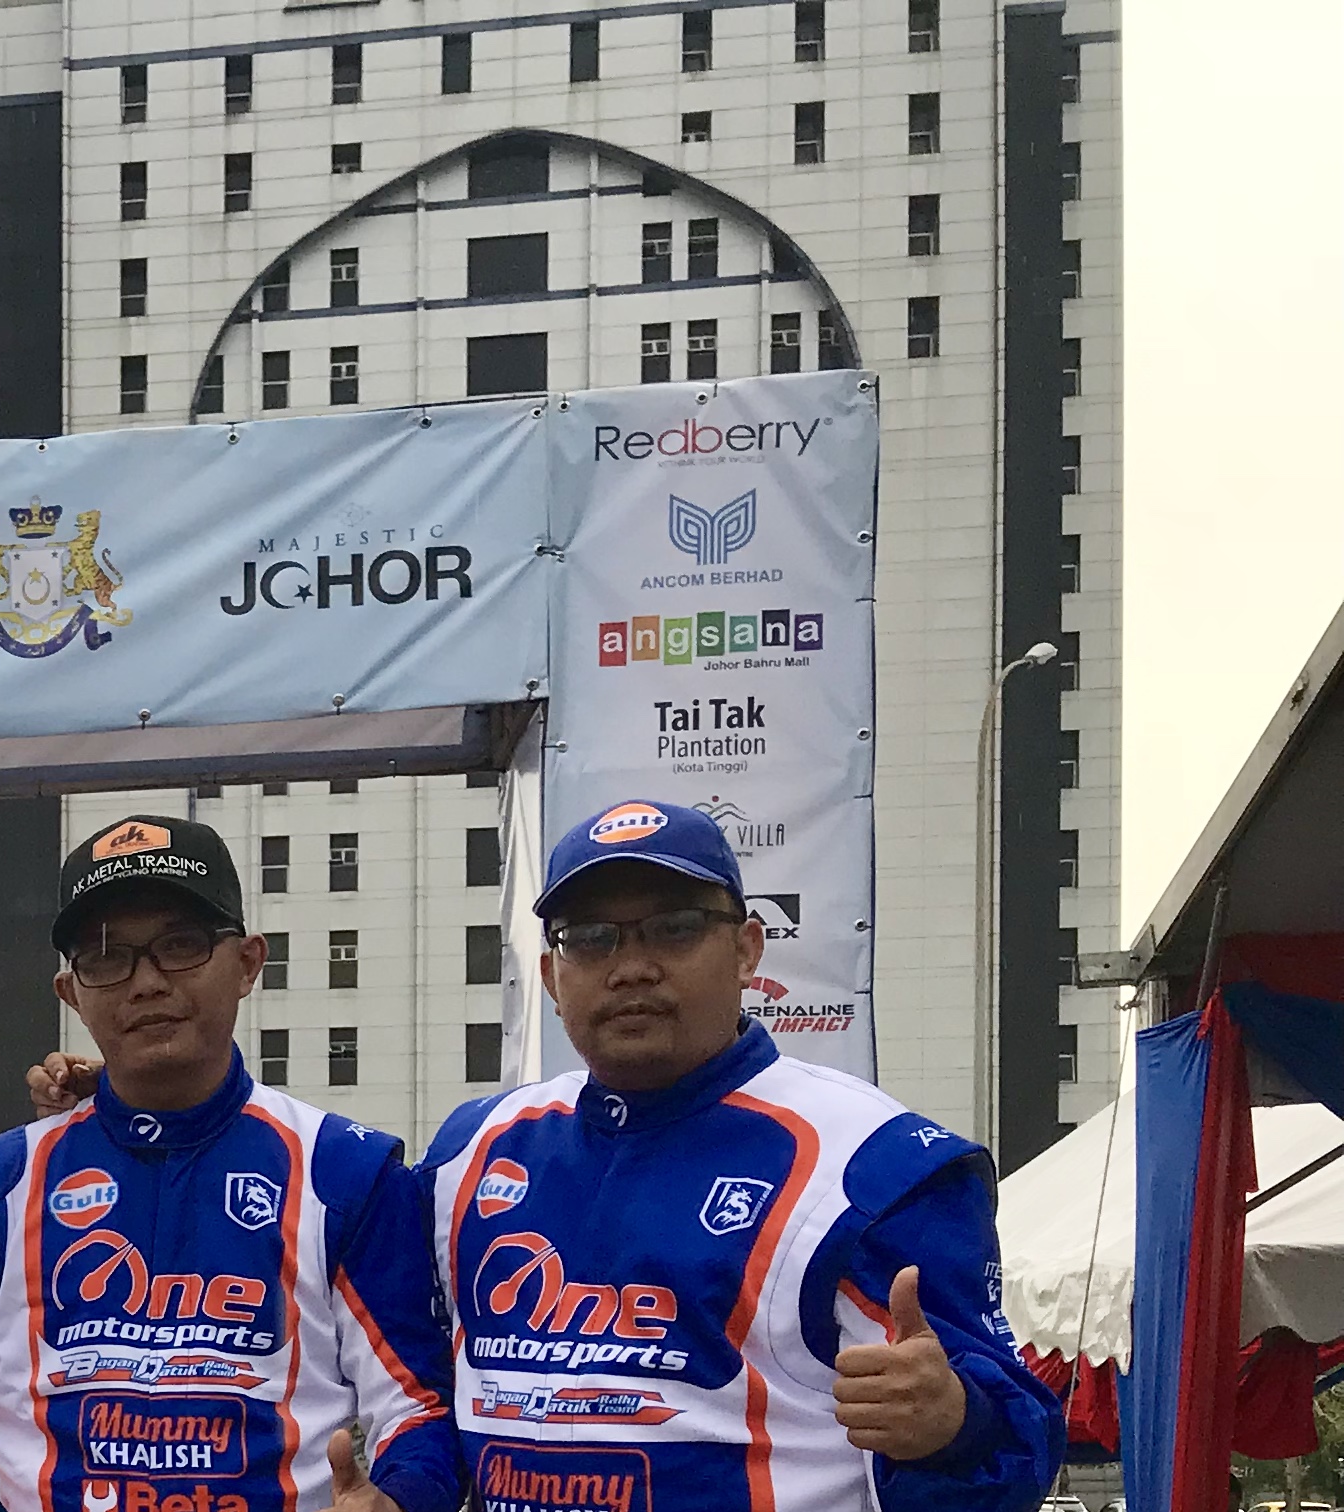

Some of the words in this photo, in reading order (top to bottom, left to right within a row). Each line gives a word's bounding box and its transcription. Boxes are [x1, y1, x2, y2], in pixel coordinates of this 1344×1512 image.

[595, 418, 820, 461] Redberry
[258, 524, 444, 554] MAJESTIC
[641, 573, 704, 589] ANCOM
[711, 569, 783, 585] BERHAD
[600, 612, 822, 665] angsana
[704, 658, 741, 671] Johor
[744, 657, 781, 668] Bahru
[785, 656, 810, 667] Mall
[654, 701, 699, 732] Tai
[709, 697, 765, 729] Tak
[658, 733, 766, 759] Plantation
[673, 761, 704, 774] (Kota
[708, 760, 748, 774] Tinggi)
[110, 826, 150, 847] ak
[593, 816, 666, 836] Gulf
[738, 823, 785, 847] VILLA
[73, 878, 84, 899] AK
[87, 857, 132, 885] METAL
[137, 855, 207, 875] TRADING
[152, 867, 188, 877] PARTNER
[741, 1003, 855, 1017] RENALINE
[771, 1016, 855, 1033] IMPACT
[53, 1185, 117, 1212] Gulf
[480, 1177, 527, 1203] Gulf
[58, 1317, 274, 1350] motorsports
[61, 1351, 137, 1381] Bagan
[132, 1356, 200, 1382] Datuk
[474, 1335, 688, 1373] motorsports
[481, 1381, 528, 1412] Bagan
[521, 1387, 591, 1418] Datuk
[598, 1405, 634, 1413] Team
[90, 1402, 233, 1452] Mummy
[91, 1441, 212, 1470] KHALISH
